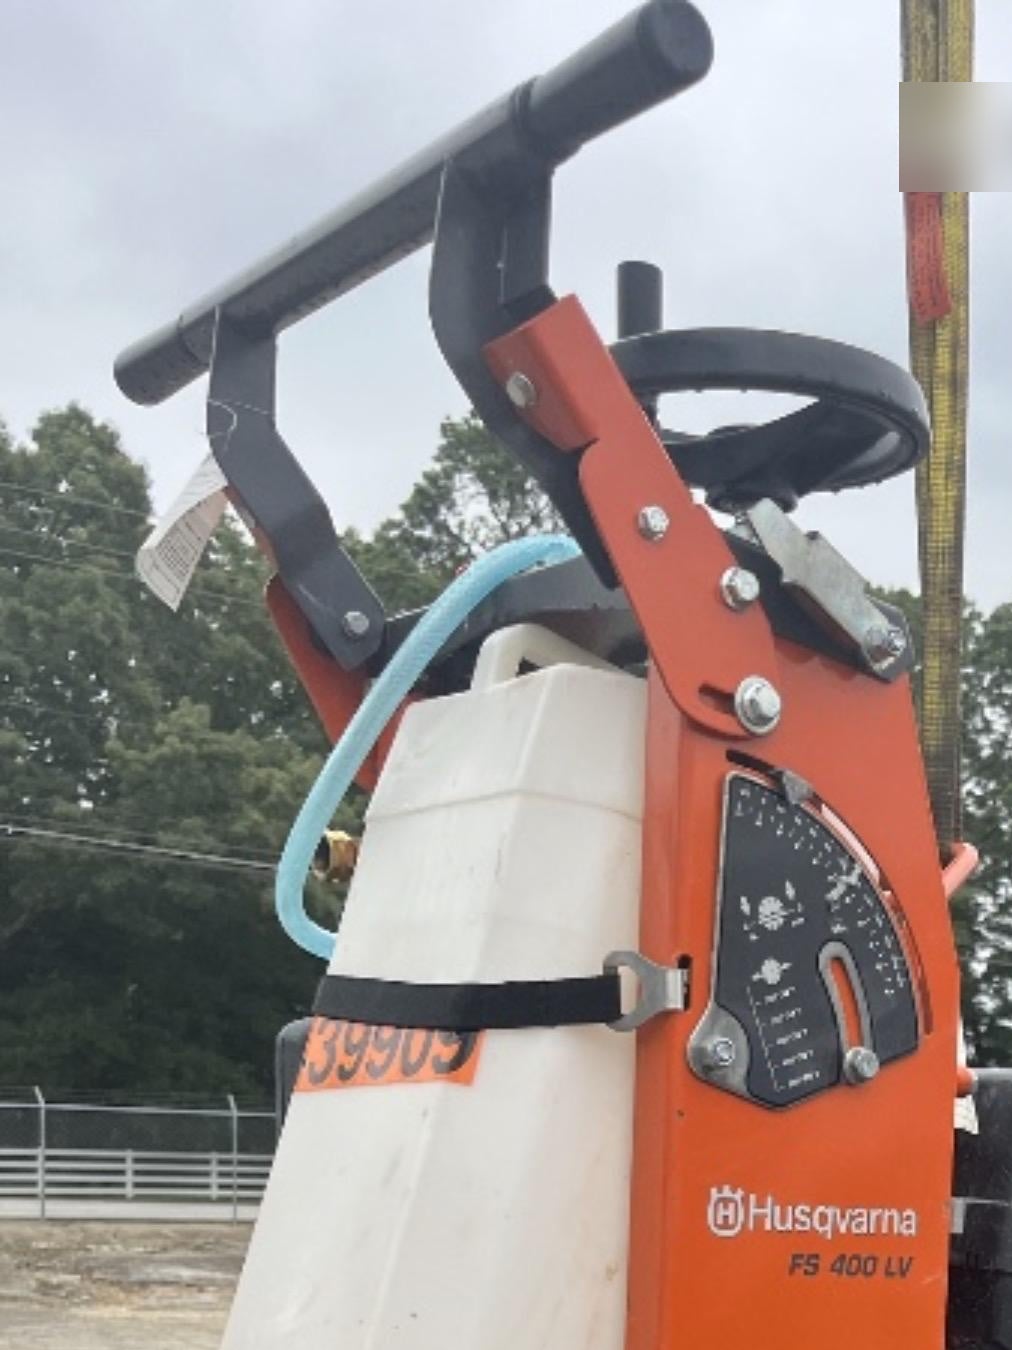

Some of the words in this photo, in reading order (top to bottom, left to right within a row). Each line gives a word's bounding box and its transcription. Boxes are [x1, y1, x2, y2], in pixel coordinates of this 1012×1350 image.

[302, 1020, 477, 1083] 39909
[749, 1193, 917, 1239] Husqvarna
[788, 1253, 820, 1275] FS
[830, 1253, 879, 1277] 400
[884, 1256, 913, 1278] LV
